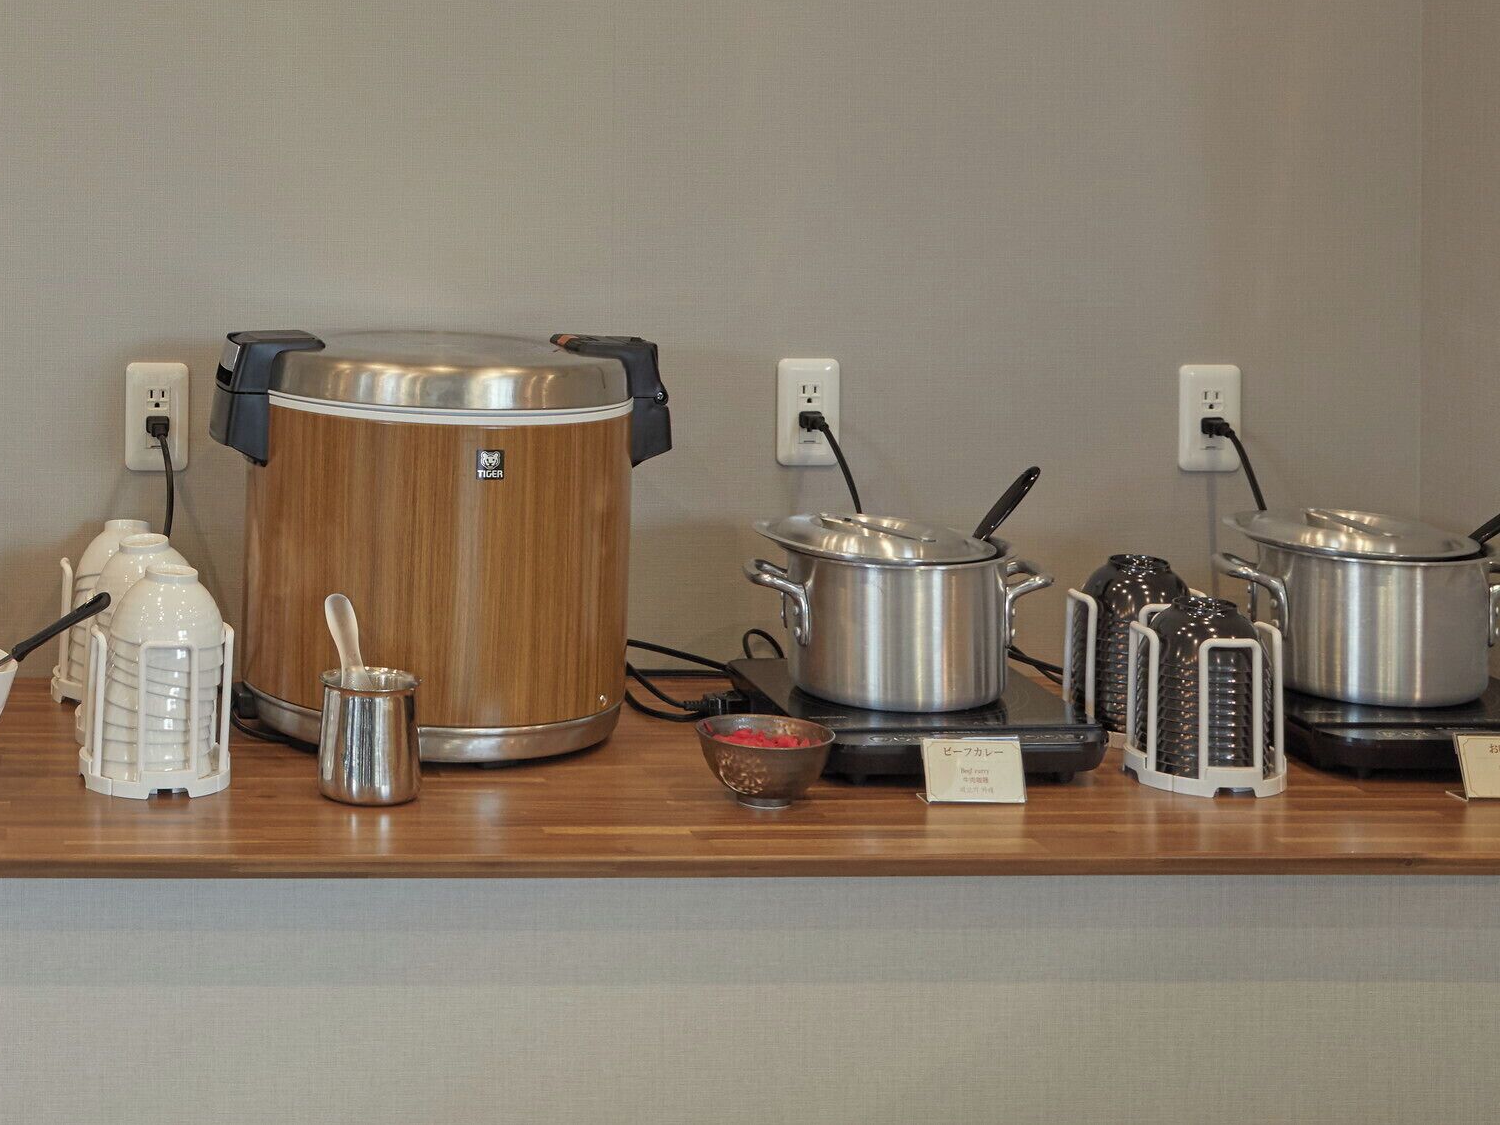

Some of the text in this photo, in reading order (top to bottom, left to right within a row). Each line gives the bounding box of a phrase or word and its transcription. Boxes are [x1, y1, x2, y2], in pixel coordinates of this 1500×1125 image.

[477, 469, 503, 478] TIGER
[943, 746, 1004, 757] ビーフカレー
[1489, 744, 1500, 754] お
